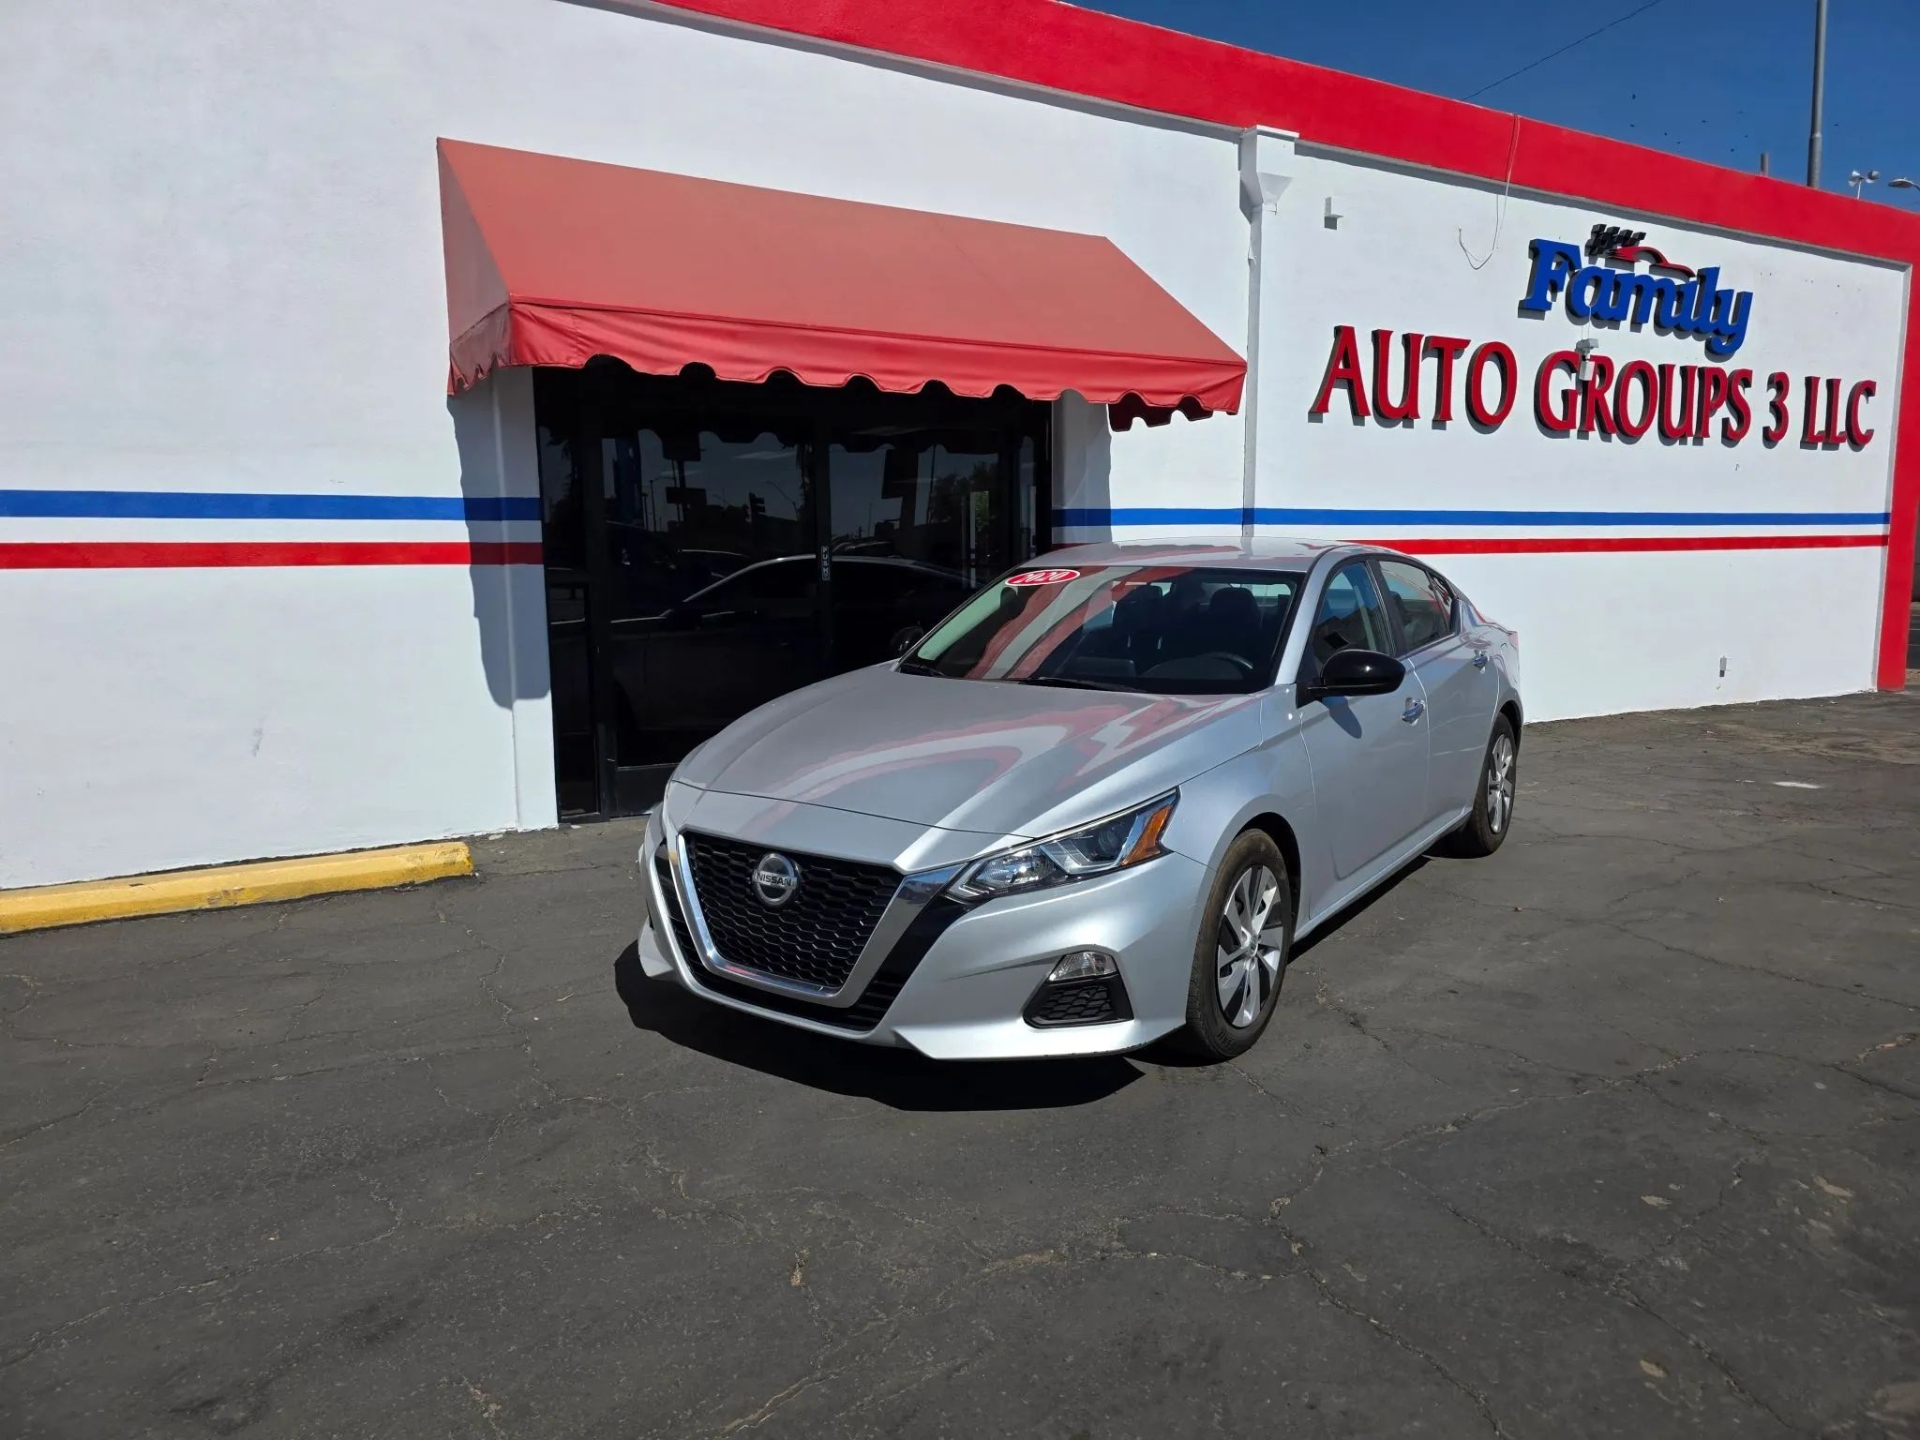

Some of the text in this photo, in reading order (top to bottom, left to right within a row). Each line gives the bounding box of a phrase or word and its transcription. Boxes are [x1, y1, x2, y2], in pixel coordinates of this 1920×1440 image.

[1518, 238, 1753, 355] Family
[1309, 325, 1877, 450] AUTO GROUPS 3 LLC
[1011, 571, 1071, 583] 2020
[757, 874, 792, 887] NISSAN
